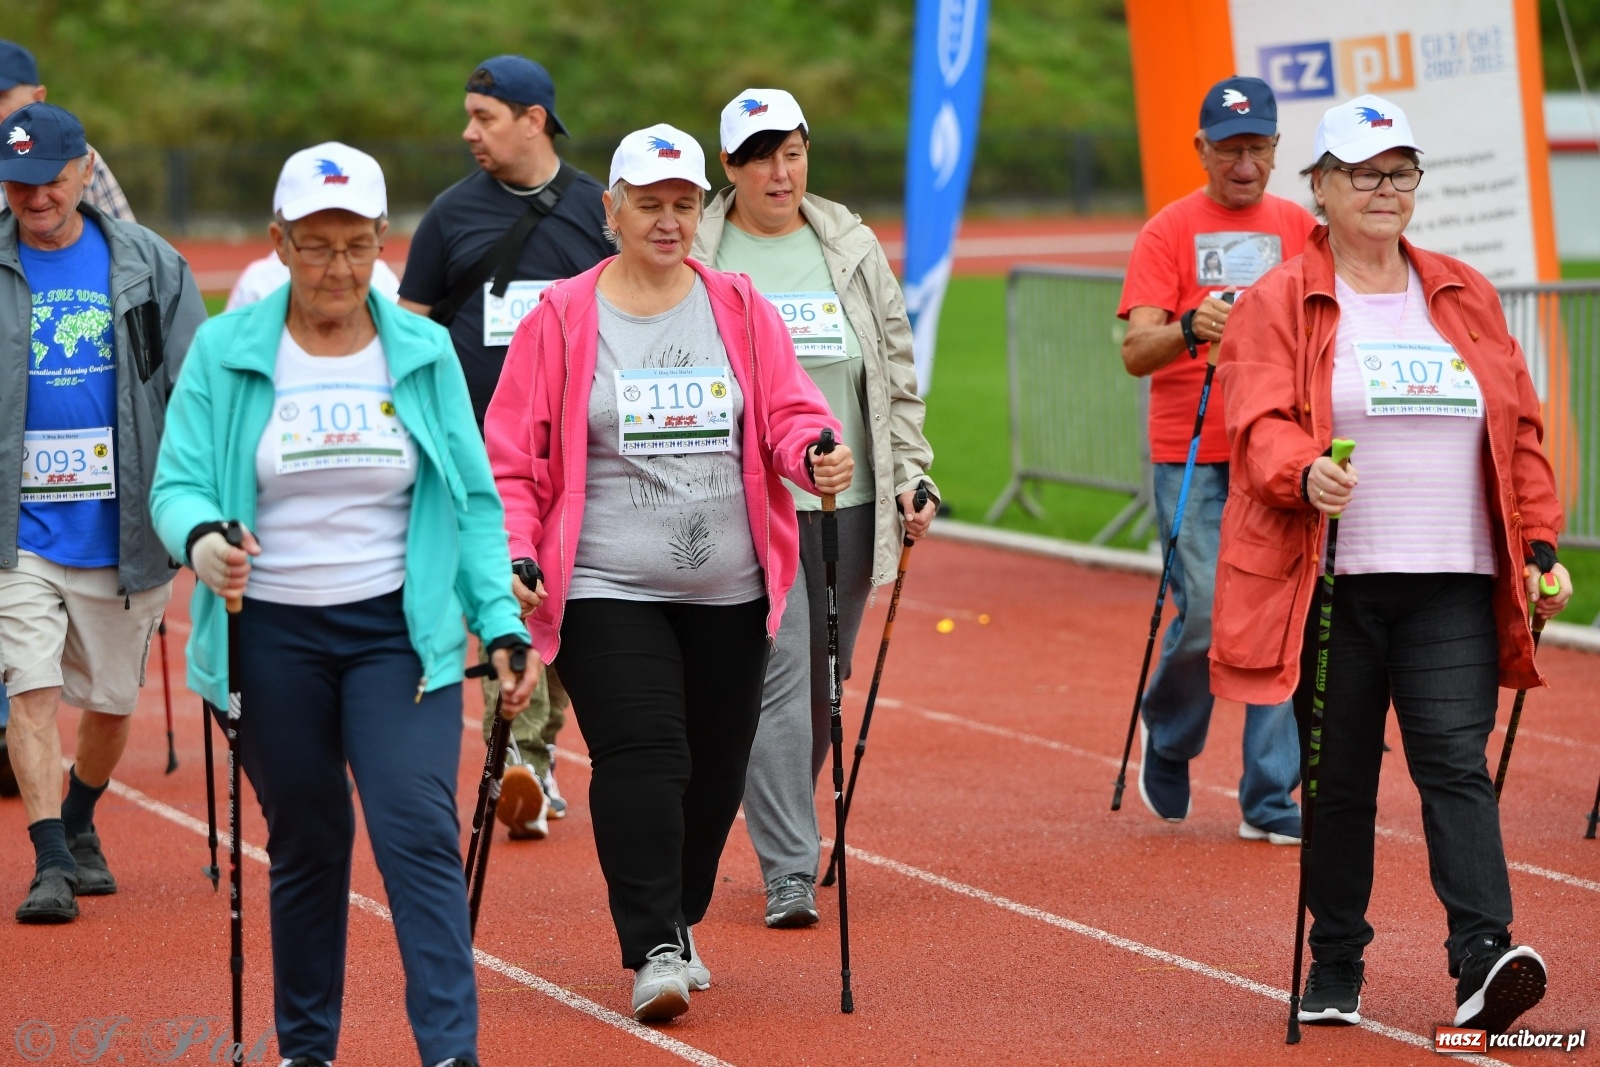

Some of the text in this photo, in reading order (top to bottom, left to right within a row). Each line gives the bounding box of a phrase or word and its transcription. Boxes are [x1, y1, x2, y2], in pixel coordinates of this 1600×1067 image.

[46, 288, 75, 303] THE
[776, 302, 816, 322] 96
[63, 366, 88, 376] Sharing
[1391, 360, 1443, 384] 107
[648, 382, 704, 410] 110
[310, 402, 373, 433] 101
[35, 448, 87, 474] 093
